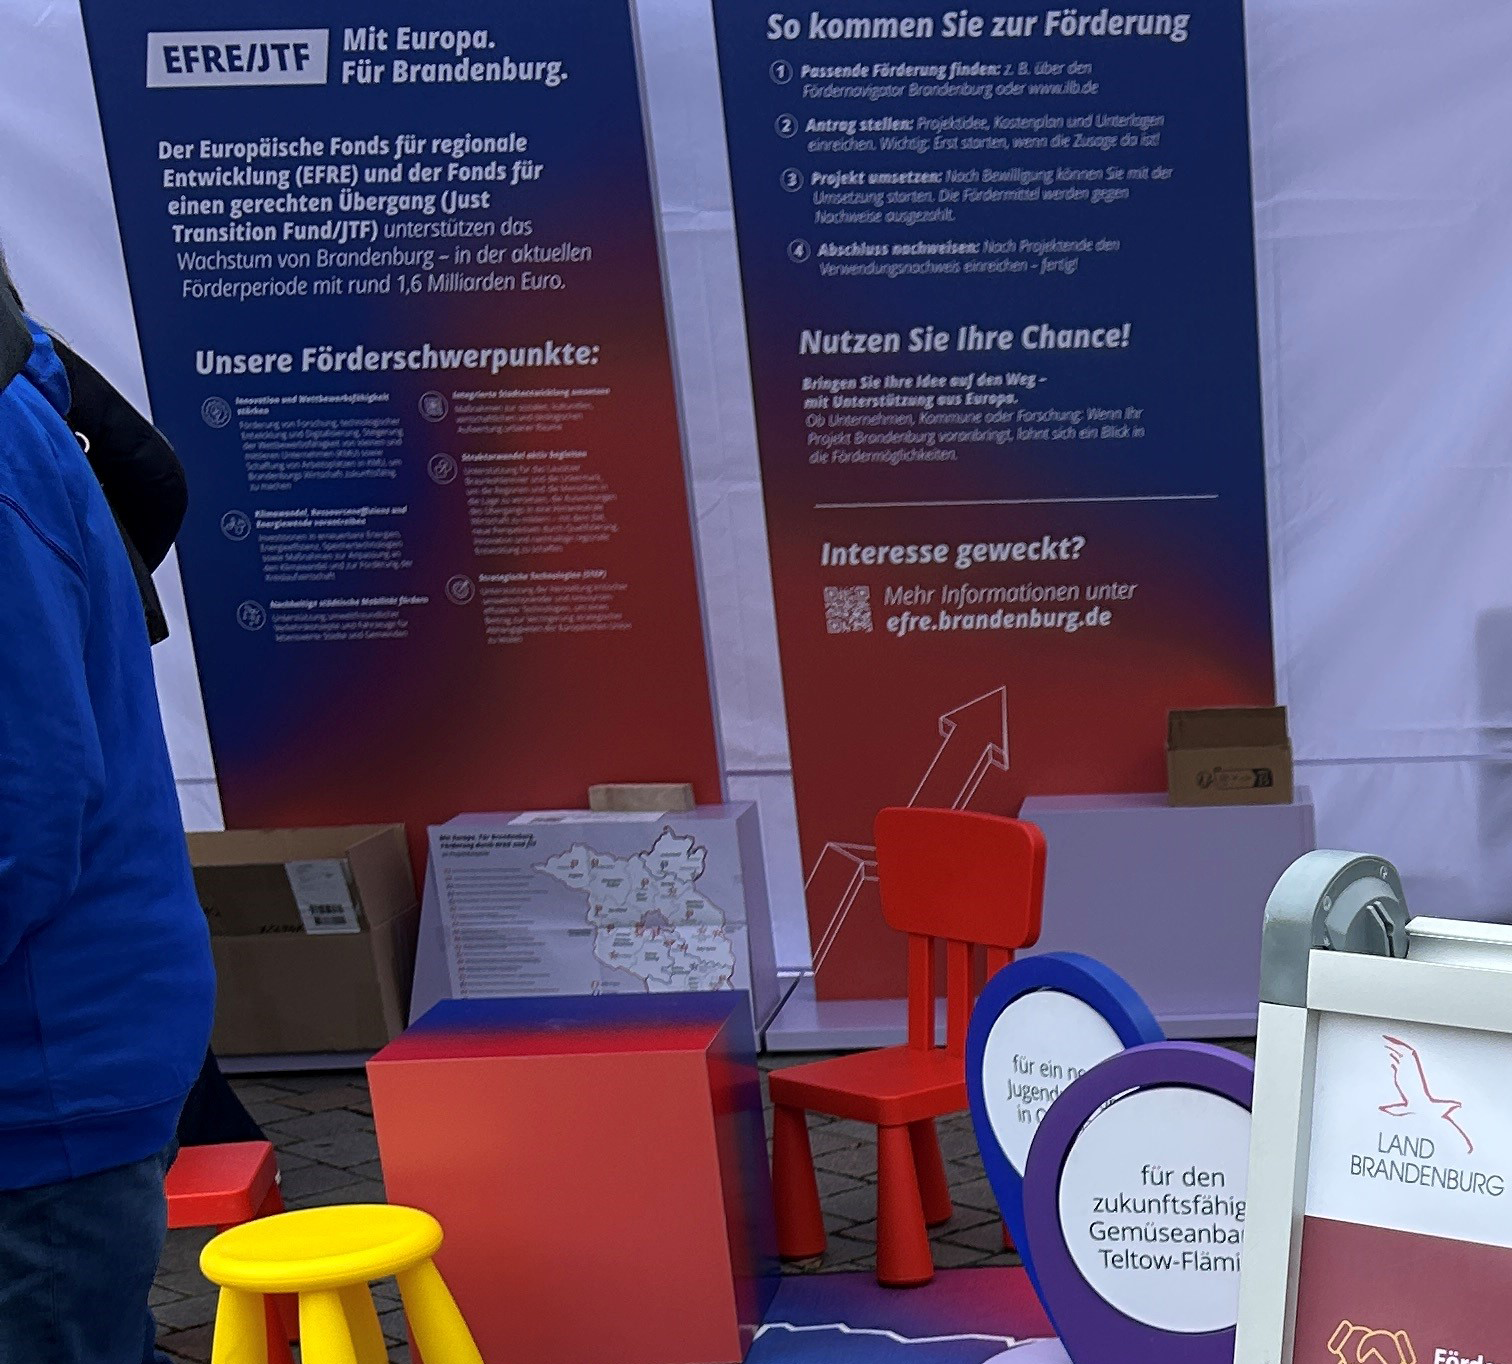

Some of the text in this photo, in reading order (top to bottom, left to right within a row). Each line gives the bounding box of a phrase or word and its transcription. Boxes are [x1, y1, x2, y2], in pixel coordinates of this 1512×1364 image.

[344, 26, 495, 55] Mit Europa.
[767, 9, 1190, 42] So kommen Sie zur Förderung
[164, 43, 309, 73] EFRE/JTF
[342, 53, 567, 87] Für Brandenburg.
[159, 132, 527, 162] Der Europäische Fonds für regionale
[164, 160, 543, 189] Entwicklung (EFRE) und der Fonds für
[168, 189, 490, 219] einen gerechten Übergang (Just
[172, 217, 532, 244] Transition Fund/JTF) unterstützen das
[183, 271, 565, 301] Förderperiode mit rund 1,6 Milliarden Euro.
[800, 323, 1131, 354] Nutzen Sie Ihre Chance!
[196, 341, 599, 374] Unsere Förderschwerpunkte:
[822, 536, 1085, 569] Interesse geweckt?
[884, 582, 1138, 609] Mehr Informationen unter
[887, 606, 1111, 637] efre.brandenburg.de
[1013, 1054, 1035, 1075] für
[1040, 1060, 1062, 1079] ein
[1007, 1079, 1059, 1104] Jugend
[1017, 1104, 1031, 1124] in
[1378, 1132, 1434, 1159] LAND
[1142, 1165, 1224, 1187] für den
[1351, 1155, 1504, 1196] BRANDENBURG
